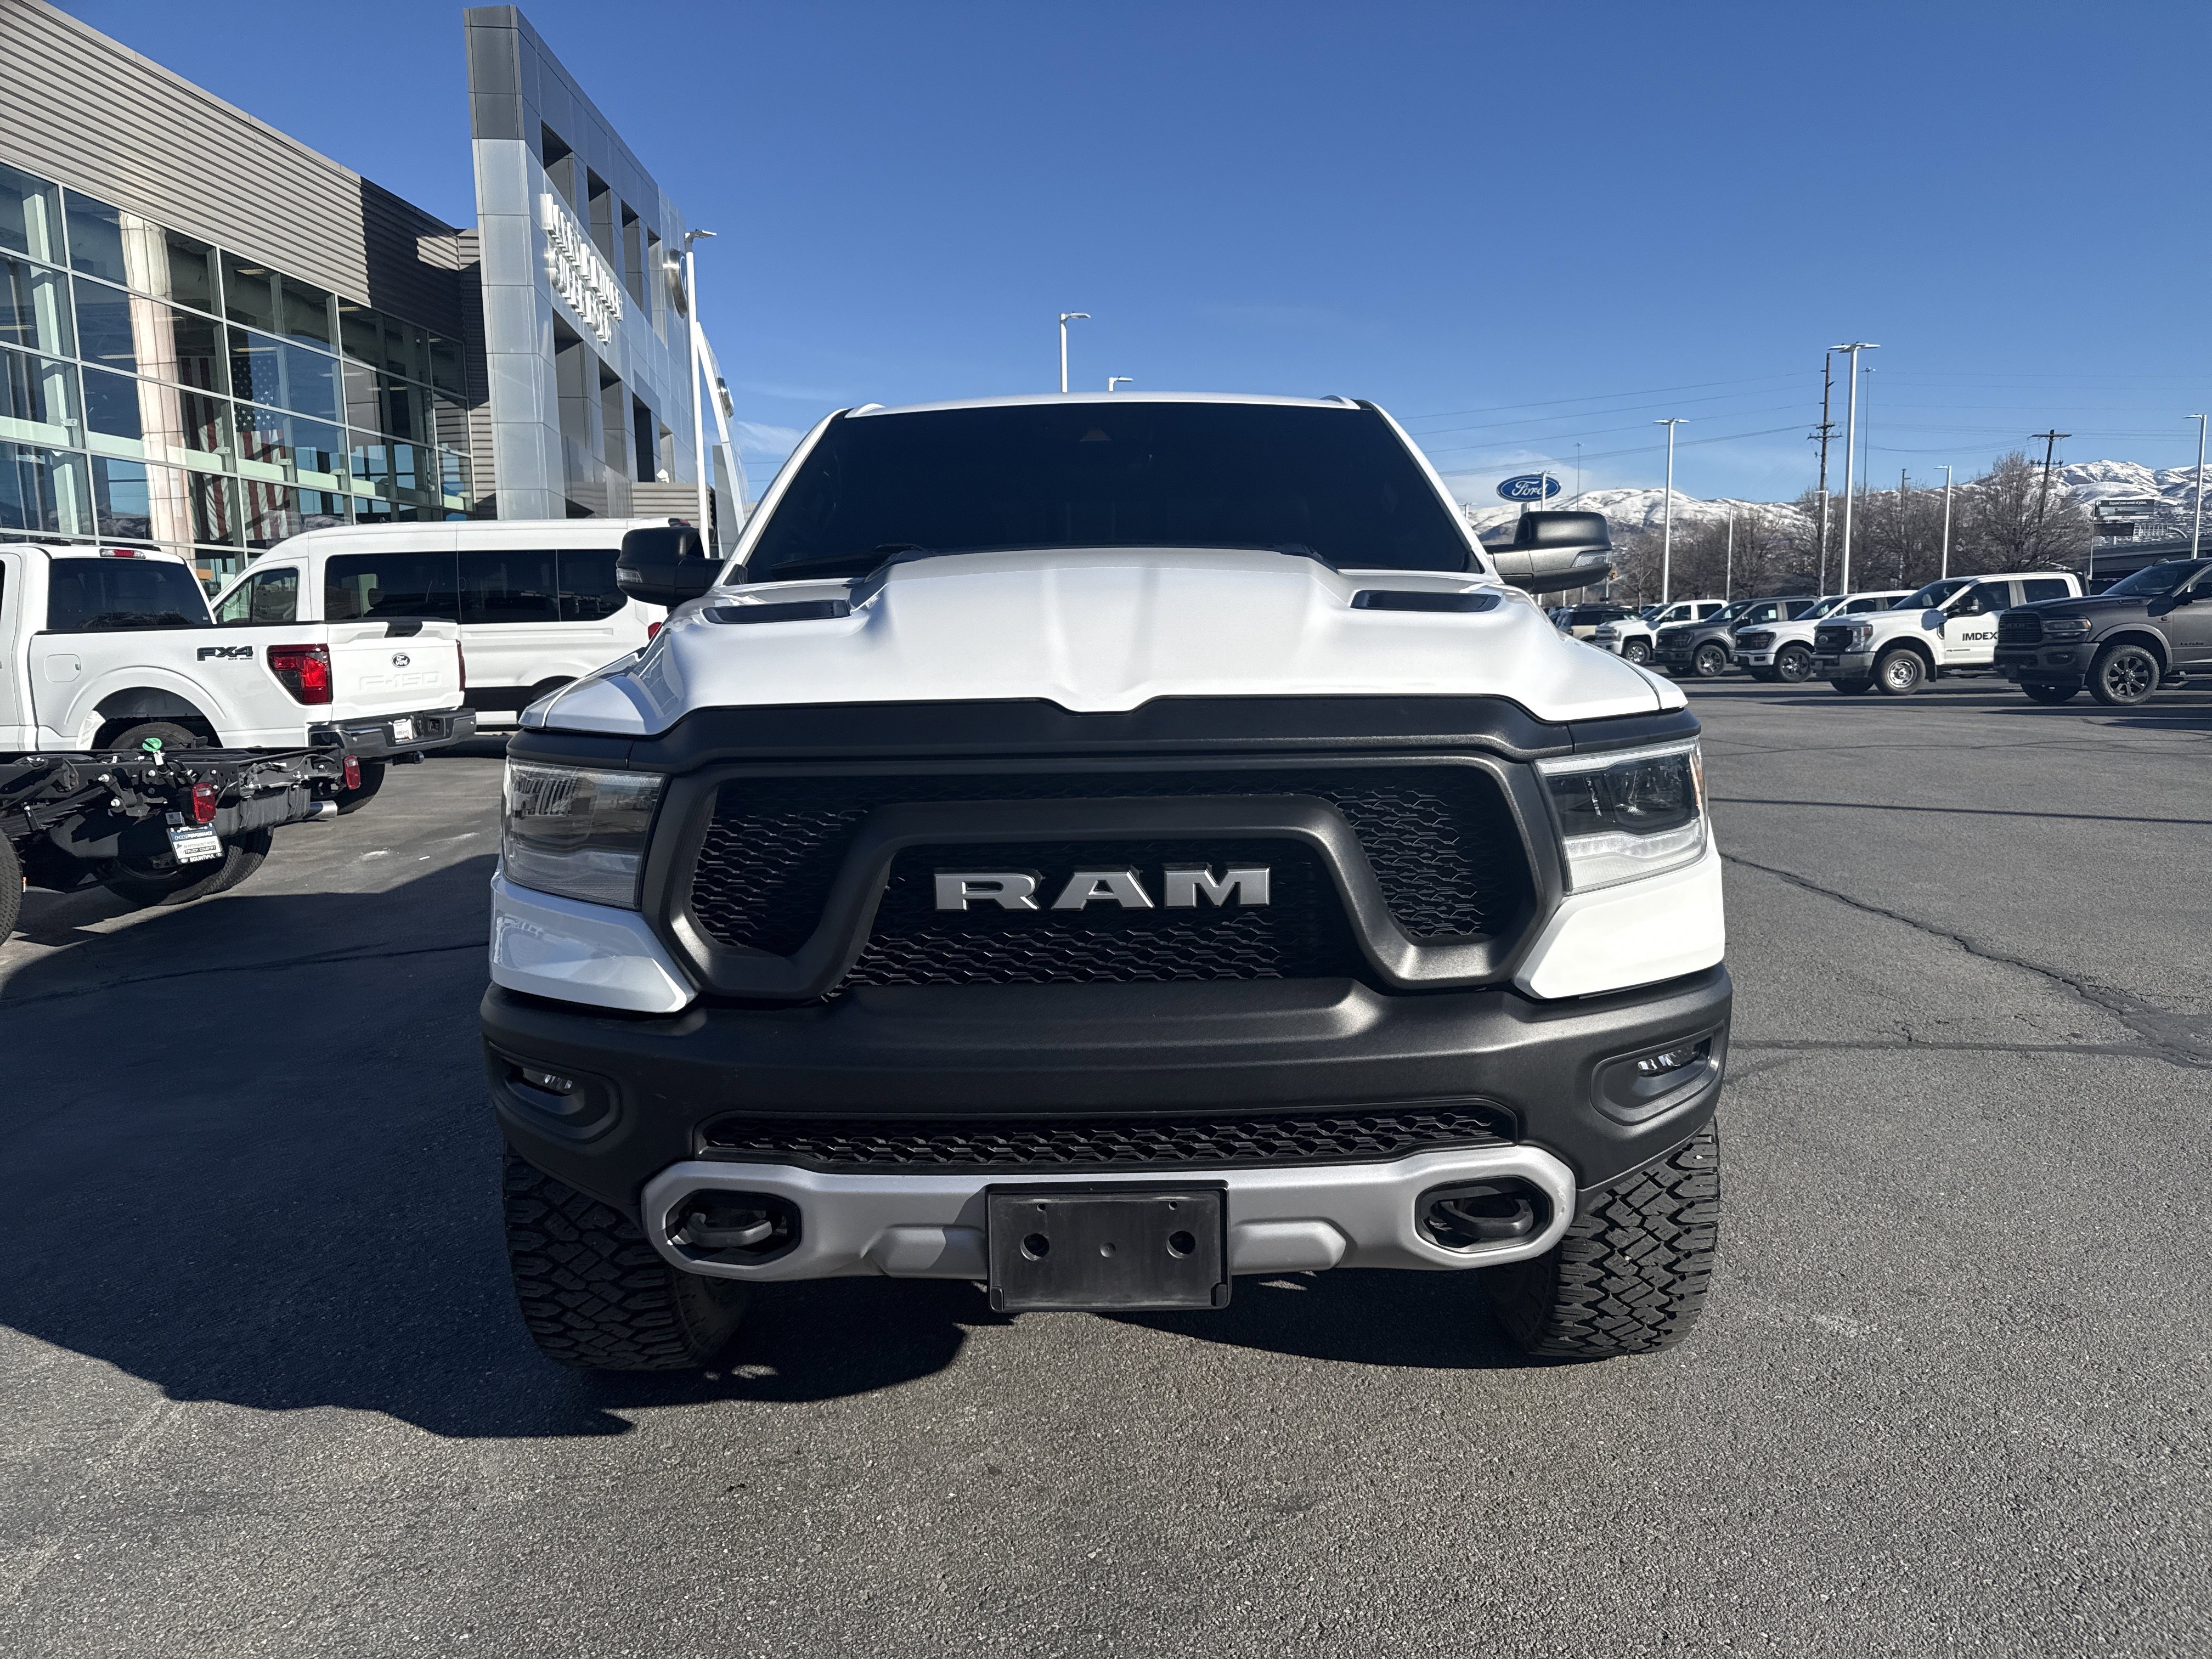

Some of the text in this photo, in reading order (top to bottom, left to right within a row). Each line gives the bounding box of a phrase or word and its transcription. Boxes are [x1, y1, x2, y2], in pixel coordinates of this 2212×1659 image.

[1962, 631, 1997, 641] IMDEX
[197, 646, 253, 661] FX4
[396, 656, 408, 665] Ford
[359, 671, 441, 691] F-150
[935, 867, 1270, 911] RAM
